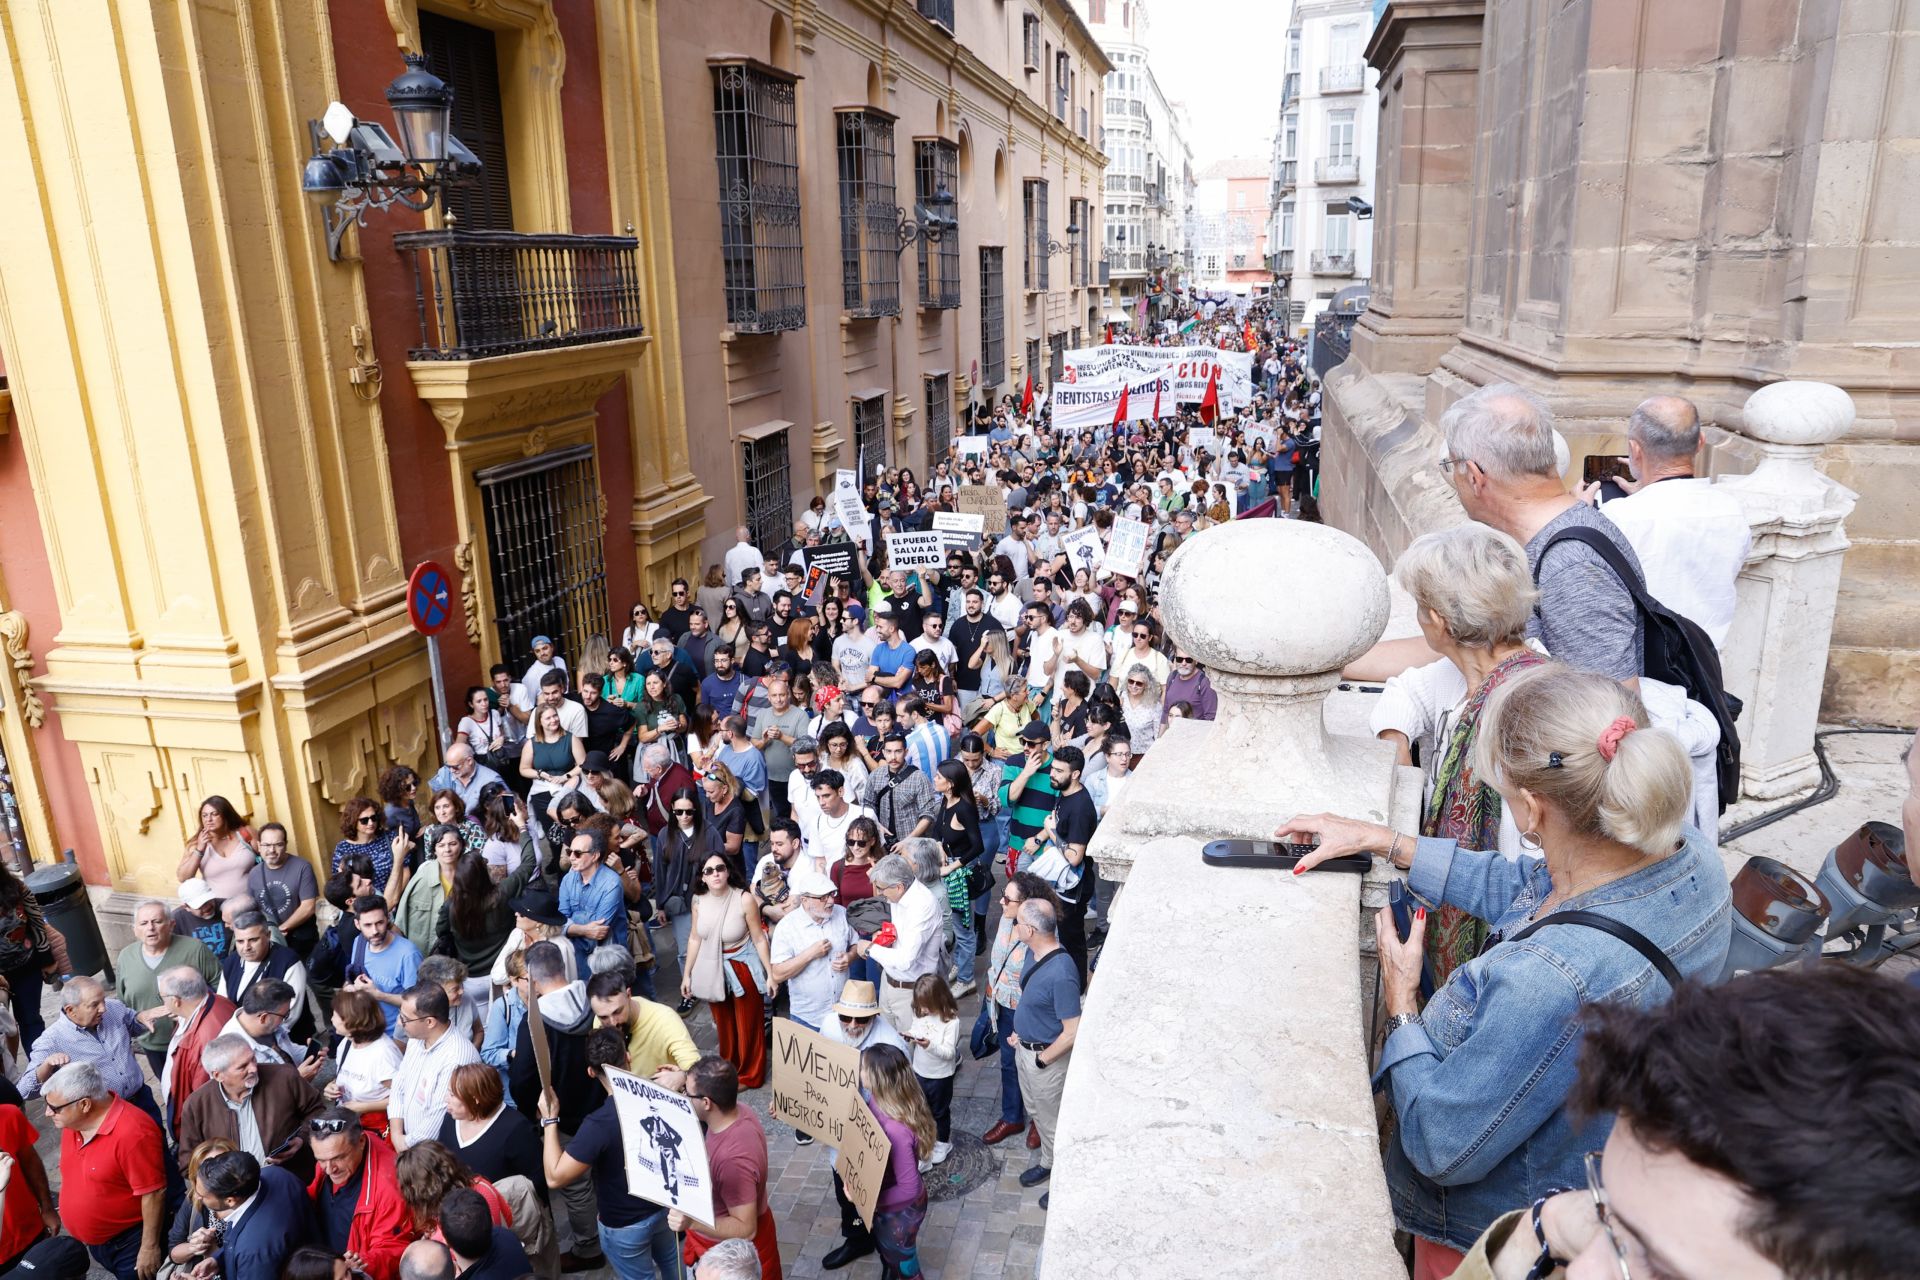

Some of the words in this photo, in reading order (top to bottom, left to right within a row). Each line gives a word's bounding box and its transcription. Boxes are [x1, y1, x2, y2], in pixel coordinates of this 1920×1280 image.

[1178, 359, 1222, 380] CIÓN
[1056, 391, 1110, 405] RENTISTAS
[894, 545, 925, 554] SALVA
[926, 543, 938, 552] AL
[903, 535, 938, 544] PUEBLO
[895, 554, 940, 566] PUEBLO
[777, 1031, 858, 1088] VIVIENDA
[612, 1076, 629, 1093] SIN
[629, 1079, 692, 1115] BOQUERONES
[804, 1081, 829, 1107] PARA
[773, 1088, 825, 1129] NUESTROS
[828, 1117, 844, 1143] HIJ
[848, 1095, 885, 1162] DERECHO
[857, 1150, 865, 1166] A
[844, 1156, 868, 1207] TECHO
